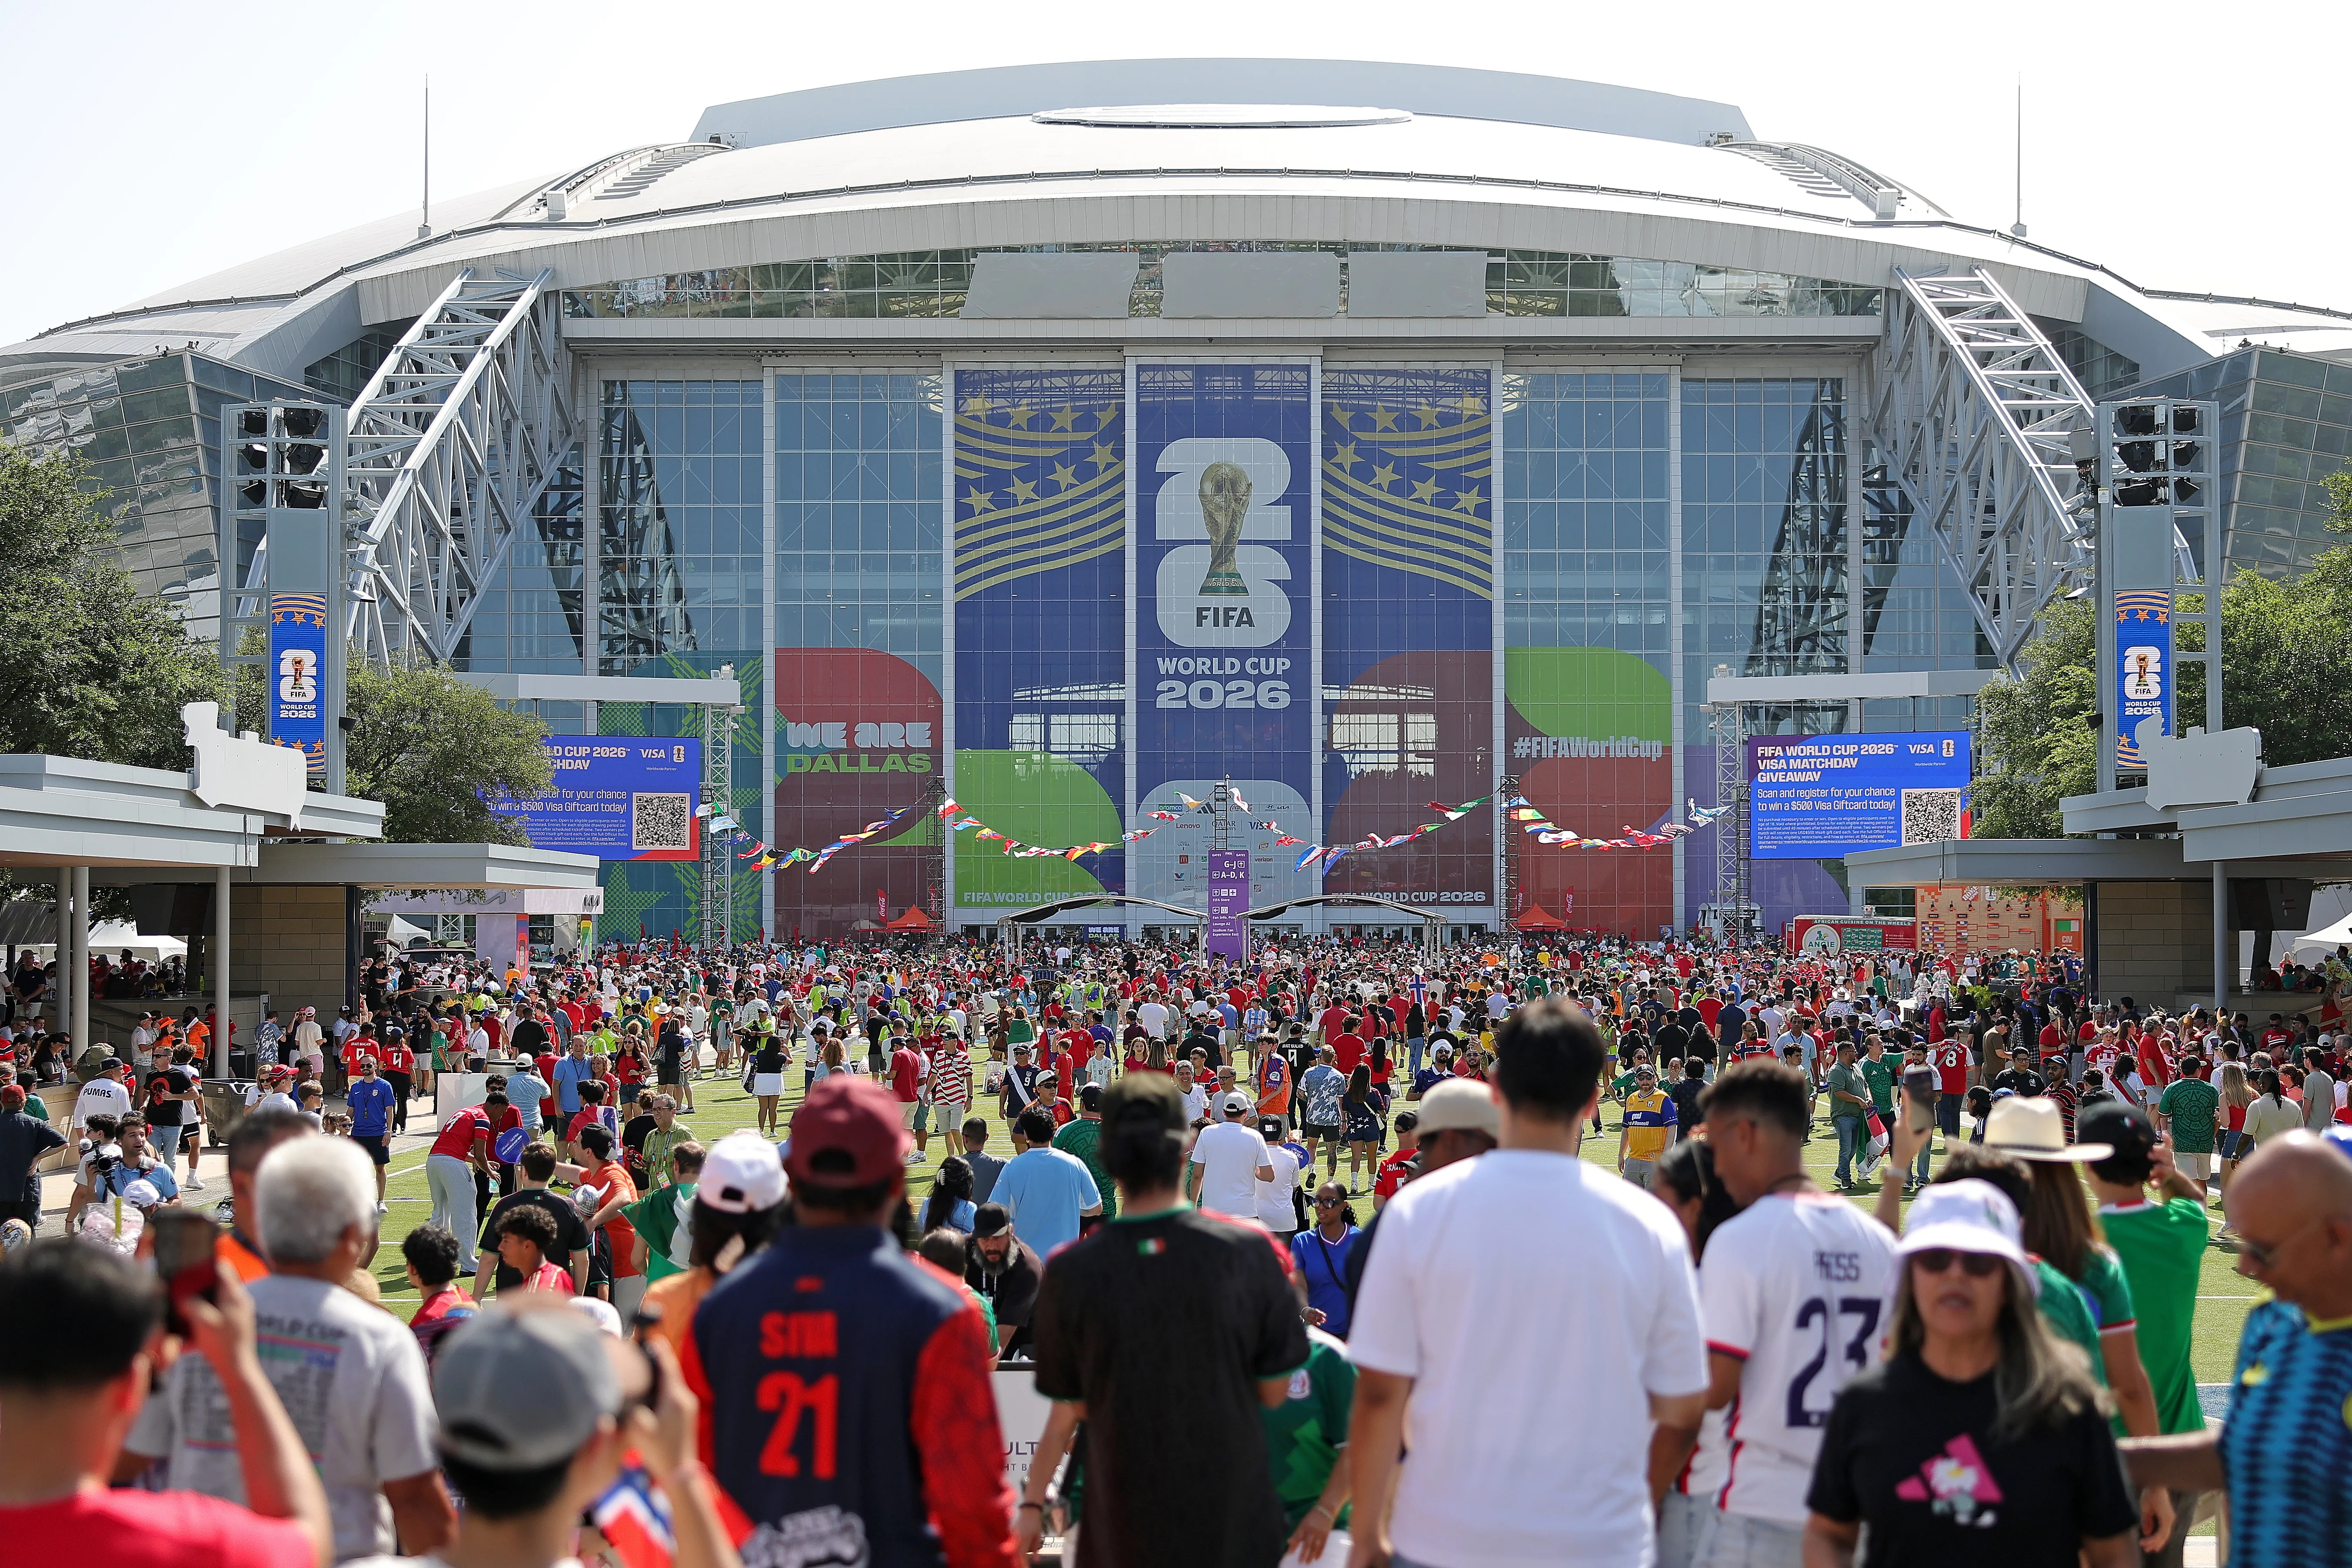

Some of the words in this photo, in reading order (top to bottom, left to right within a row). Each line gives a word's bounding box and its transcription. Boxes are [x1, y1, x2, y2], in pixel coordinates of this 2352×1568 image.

[1196, 607, 1255, 627] FIFA
[1157, 658, 1241, 675] WORLD
[1245, 658, 1291, 675] CUP
[1156, 680, 1291, 709] 2026
[787, 722, 847, 748] WE
[854, 722, 932, 748] ARE
[565, 746, 591, 757] CUP
[639, 749, 666, 758] VISA
[1513, 736, 1662, 762] #FIFAWorldCup
[1757, 746, 1783, 757] FIFA
[1785, 745, 1830, 756] WORLD
[1832, 744, 1858, 755] CUP
[1907, 744, 1935, 754] VISA
[550, 759, 590, 770] CHDAY
[787, 753, 932, 773] DALLAS
[1757, 759, 1787, 770] VISA
[1789, 757, 1858, 769] MATCHDAY
[1757, 771, 1821, 782] GIVEAWAY
[562, 789, 575, 798] for
[576, 791, 595, 800] your
[596, 789, 626, 799] chance
[1757, 789, 1778, 798] Scan
[1780, 788, 1795, 797] and
[1797, 788, 1829, 799] register
[1830, 787, 1843, 797] for
[1844, 789, 1863, 798] your
[1865, 787, 1895, 796] chance
[498, 801, 512, 811] win
[521, 801, 543, 811] $500
[545, 801, 563, 811] Visa
[565, 802, 599, 812] Giftcard
[601, 802, 627, 814] today!
[1758, 802, 1767, 811] to
[1769, 801, 1782, 811] win
[1791, 801, 1813, 811] $500
[1814, 800, 1832, 810] Visa
[1834, 800, 1867, 810] Giftcard
[1869, 799, 1895, 811] today!
[964, 892, 992, 902] FIFA
[993, 892, 1041, 902] WORLD
[1044, 892, 1070, 902] CUP
[1411, 892, 1437, 902] CUP
[1440, 892, 1486, 902] 2026
[1644, 1009, 1656, 1021] 10
[1945, 1050, 1957, 1067] 8
[1024, 1077, 1030, 1086] 9
[83, 1087, 111, 1098] PUMAS
[1787, 1299, 1881, 1428] 23
[756, 1369, 839, 1478] 21
